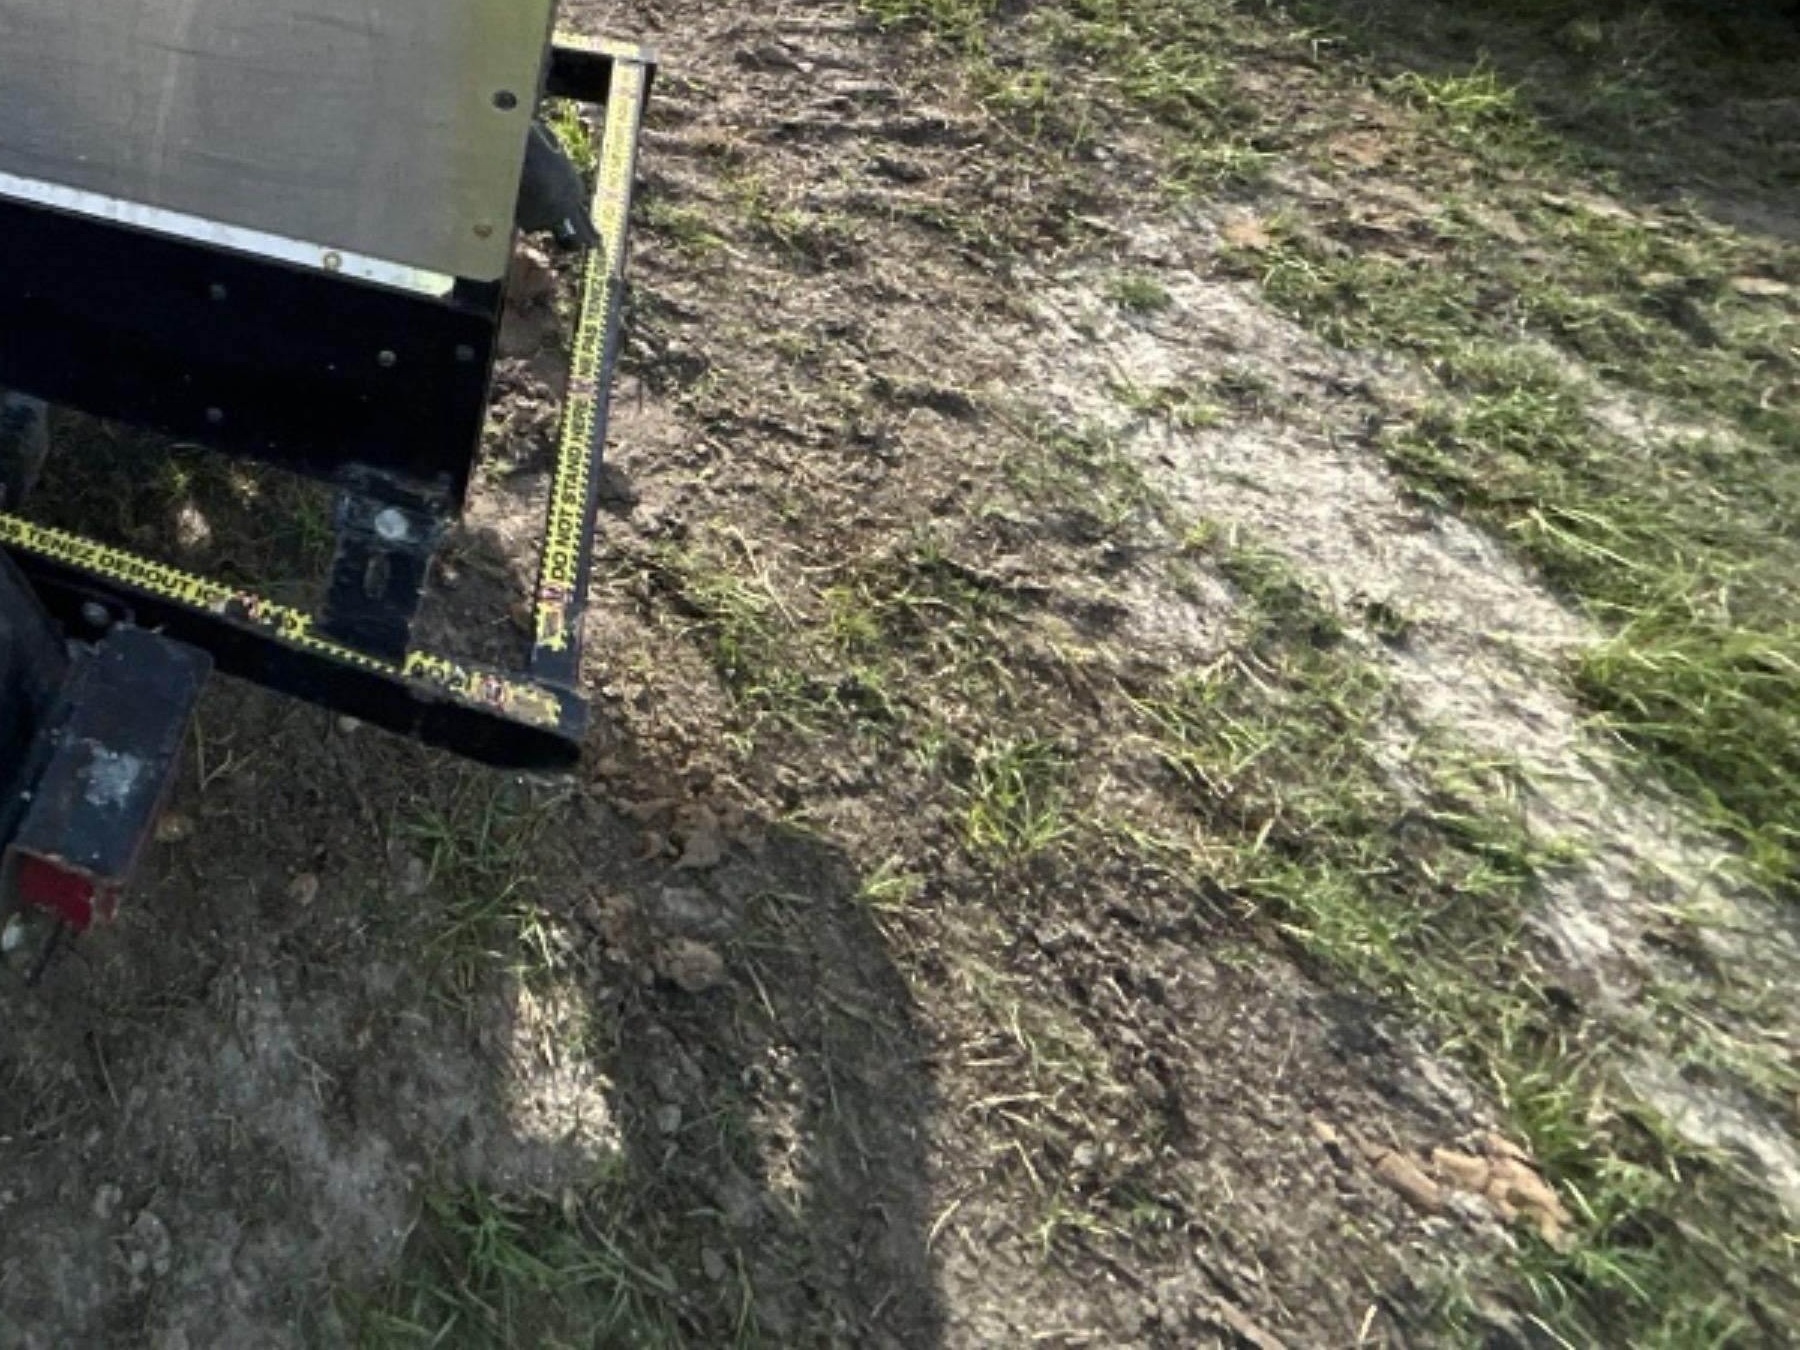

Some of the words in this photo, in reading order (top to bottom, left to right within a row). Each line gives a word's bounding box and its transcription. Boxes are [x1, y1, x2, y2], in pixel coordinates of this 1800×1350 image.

[561, 446, 583, 505] STAND
[555, 508, 574, 546] NOT
[28, 526, 92, 561] TENEZ
[98, 552, 192, 594] DEBOUT
[551, 551, 568, 580] DO
